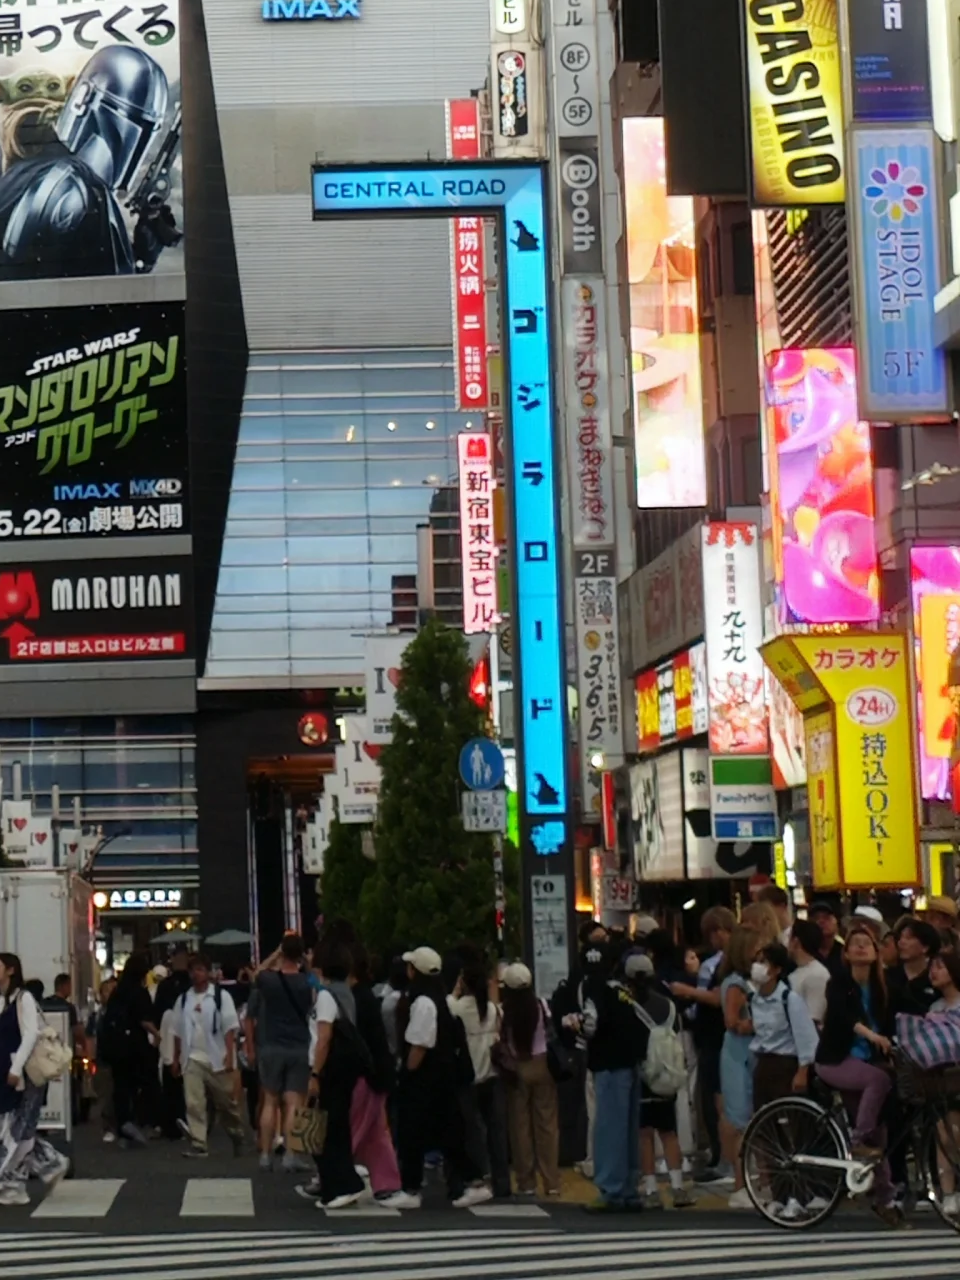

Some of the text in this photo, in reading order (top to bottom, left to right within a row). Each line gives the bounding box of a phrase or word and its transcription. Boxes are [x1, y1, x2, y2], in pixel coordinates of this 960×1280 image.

[324, 179, 506, 199] CENTRAL ROAD
[562, 154, 598, 253] Booth
[877, 230, 903, 322] STAGE
[900, 230, 923, 302] IDOL
[25, 327, 141, 375] STAR WARS
[574, 305, 600, 392] カラオケ
[884, 350, 924, 378] 5F
[4, 430, 38, 448] アンド
[36, 394, 158, 476] グローグー
[54, 482, 123, 501] IMAX
[578, 416, 608, 541] まねきねこ
[512, 306, 553, 721] ゴジラロード
[466, 471, 494, 623] 新宿東宝ビル
[580, 552, 610, 574] 2F
[51, 573, 182, 613] MARUHAN
[16, 636, 176, 658] 2F店舗出入口はビル左側
[722, 610, 748, 664] 九十九
[814, 647, 902, 670] カラオケ
[716, 791, 772, 806] FamilyMart
